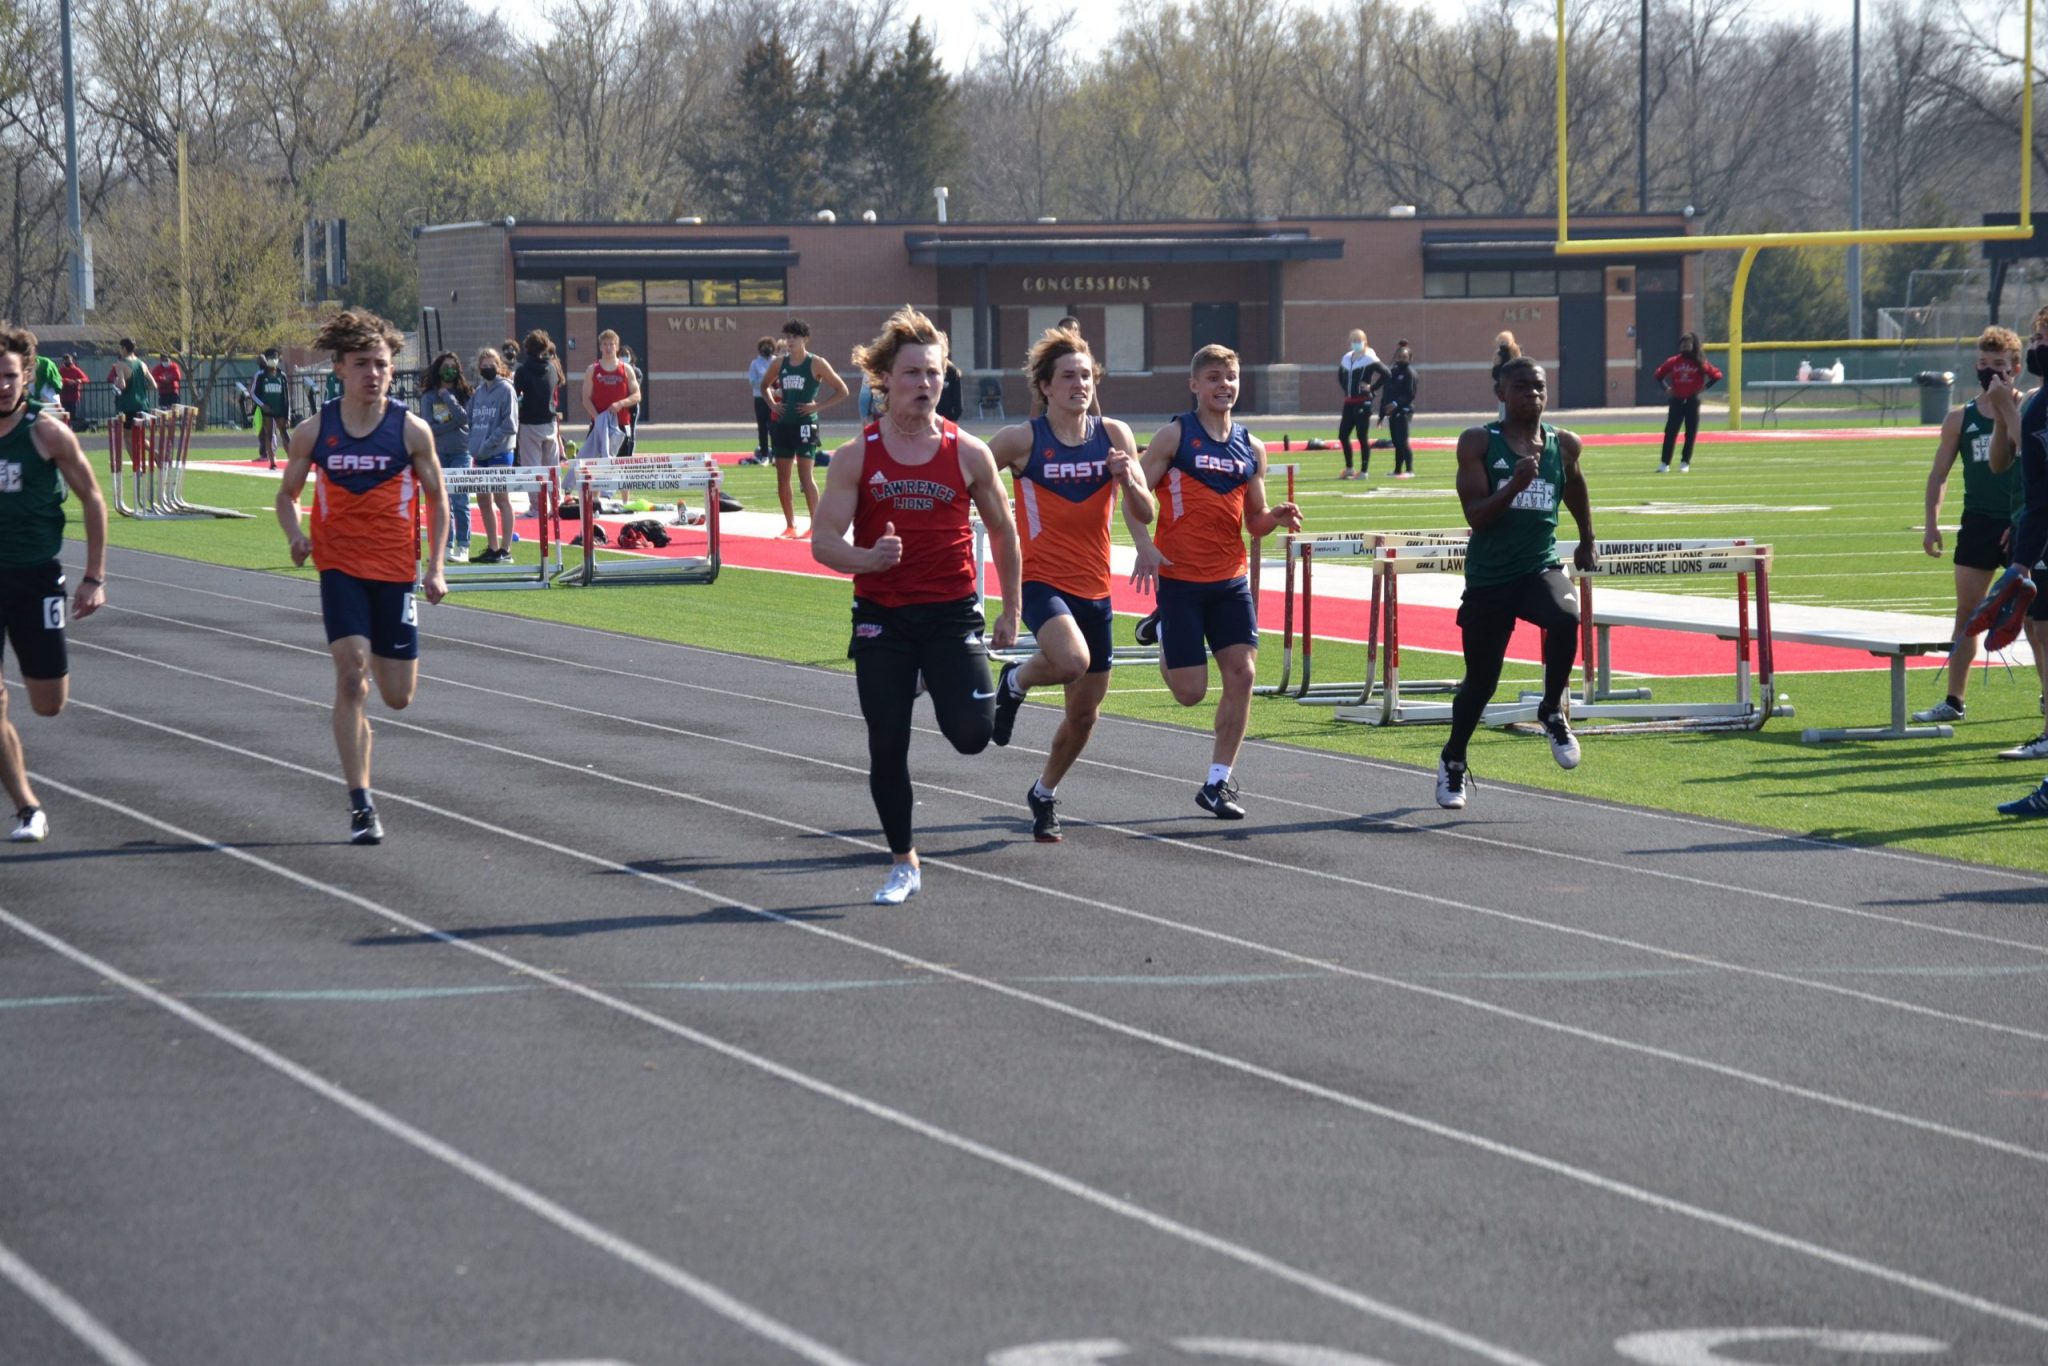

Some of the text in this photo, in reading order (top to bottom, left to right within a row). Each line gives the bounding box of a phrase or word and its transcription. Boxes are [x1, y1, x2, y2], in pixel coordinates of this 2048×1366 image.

[1022, 276, 1150, 291] CONCESSIONS
[1503, 307, 1542, 321] MEN
[667, 316, 737, 331] WOMEN
[327, 455, 391, 470] EAST
[1043, 460, 1106, 479] EAST
[1195, 454, 1246, 474] EAST
[454, 484, 507, 493] LAWRENCE HIGH
[618, 480, 656, 490] LAWRENCE
[659, 480, 680, 489] LIONS
[871, 479, 957, 503] LAWRENCE
[894, 497, 934, 511] LIONS
[1600, 542, 1682, 555] LAWRENCE HIGH
[1609, 561, 1666, 575] LAWRENCE
[1672, 560, 1702, 573] LIONS
[50, 599, 60, 626] 6
